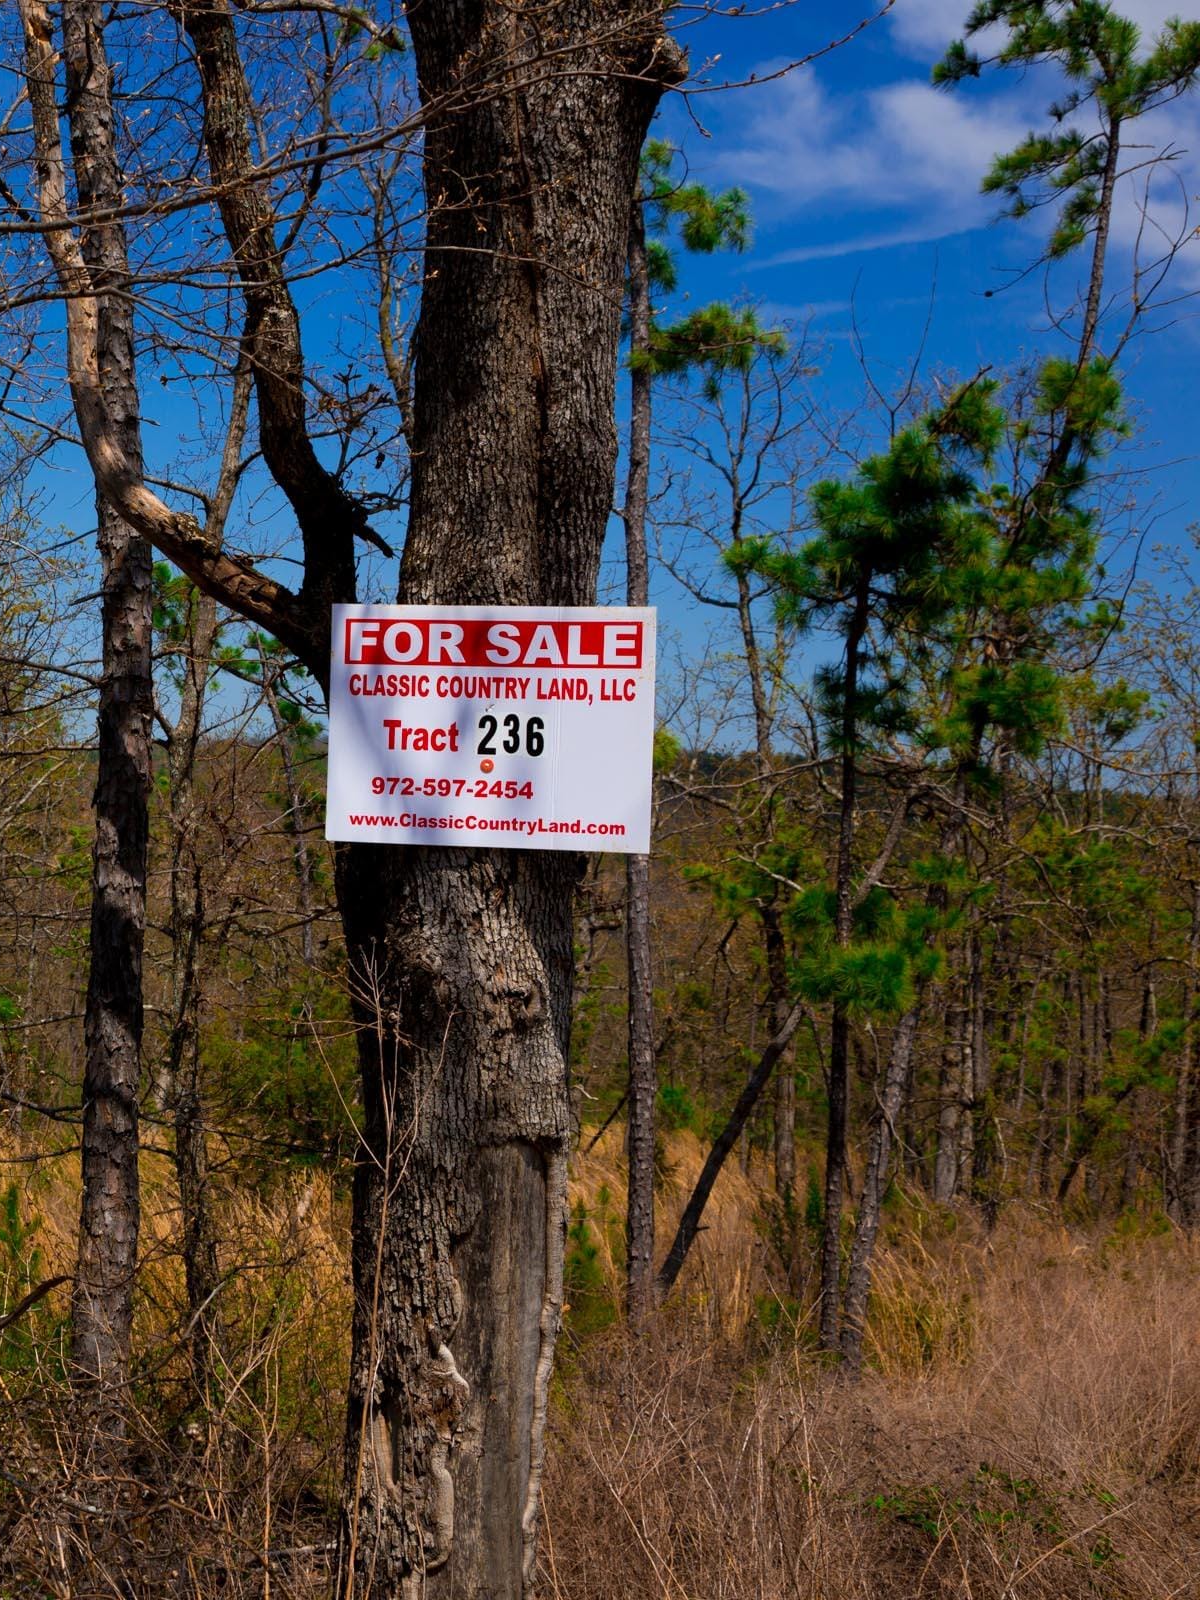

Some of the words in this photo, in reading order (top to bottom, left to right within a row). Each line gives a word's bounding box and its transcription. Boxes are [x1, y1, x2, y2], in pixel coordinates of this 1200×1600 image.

[349, 622, 466, 664] FOR
[486, 624, 638, 666] SALE
[349, 674, 430, 697] CLASSIC
[436, 676, 530, 700] COUNTRY
[537, 678, 593, 705] LAND,
[600, 679, 636, 701] LLC
[383, 719, 459, 752] Tract
[477, 714, 545, 757] 236
[371, 777, 533, 800] 972-597-2454
[349, 813, 625, 836] www.ClassicCountryLand.com
